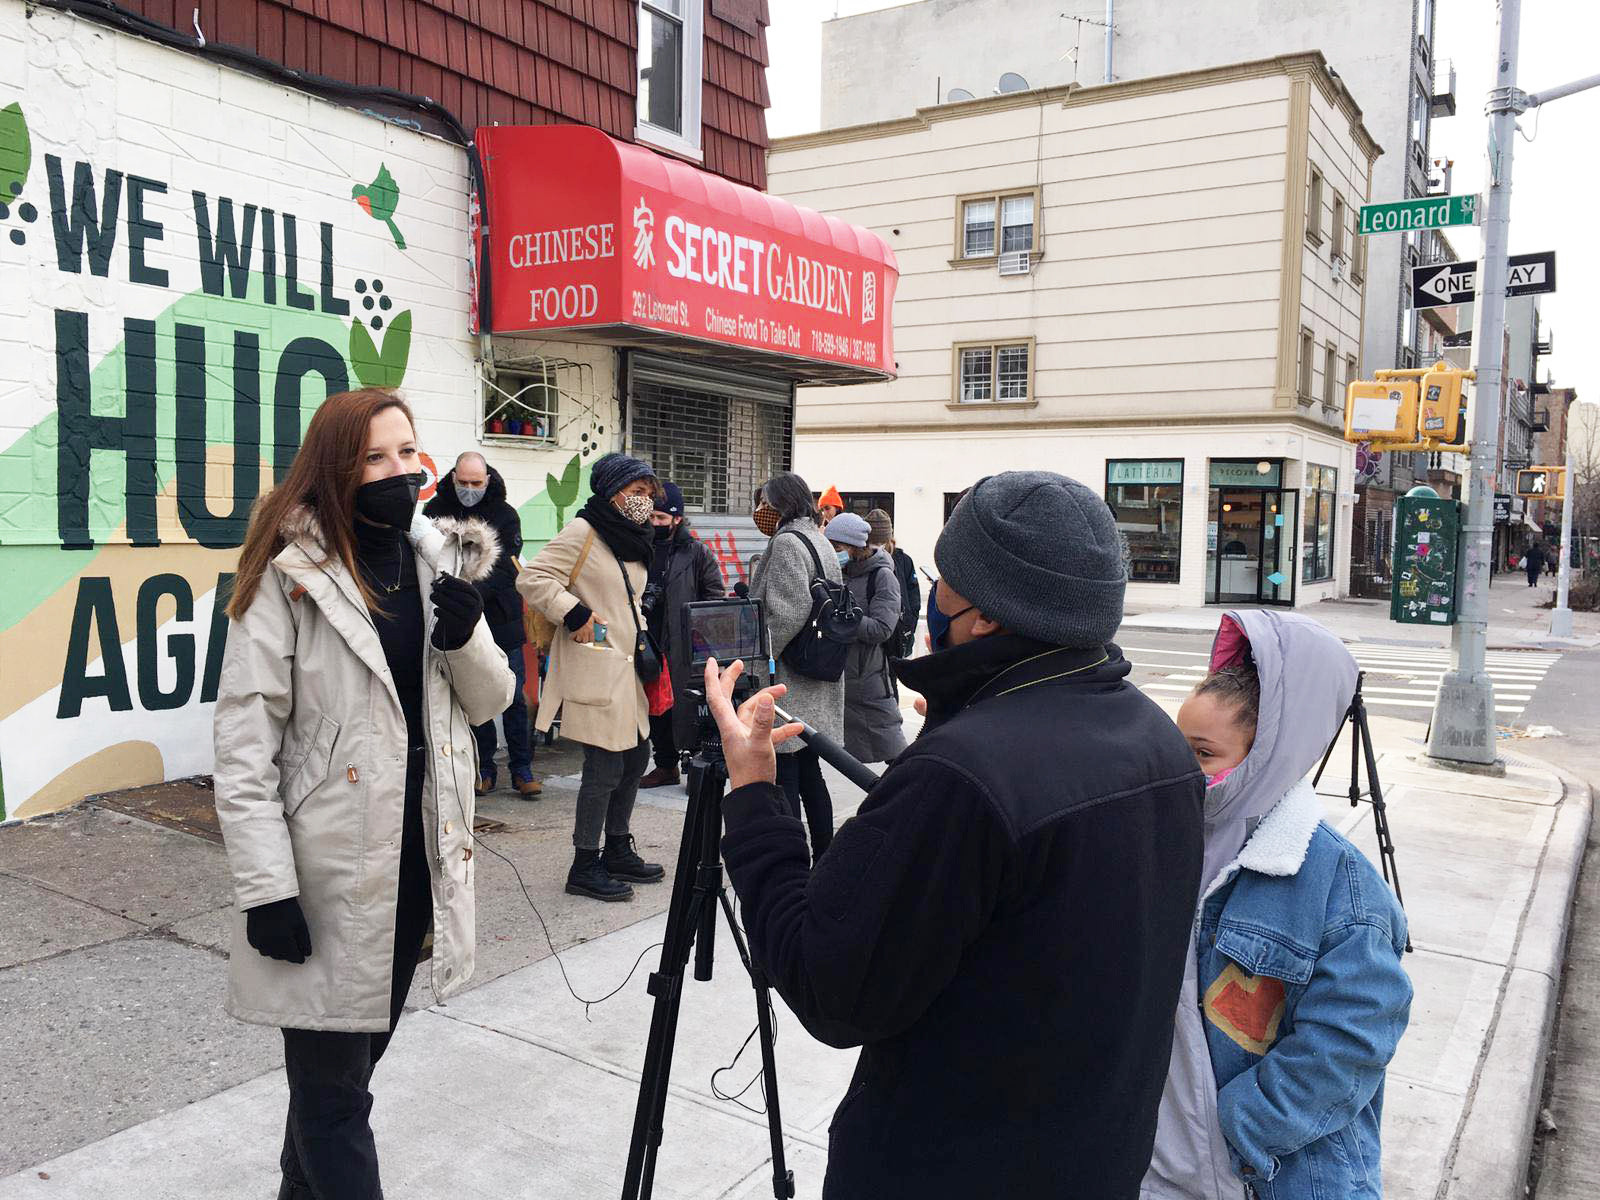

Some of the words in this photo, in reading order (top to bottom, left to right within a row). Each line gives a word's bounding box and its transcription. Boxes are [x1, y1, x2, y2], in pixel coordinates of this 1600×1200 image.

[45, 153, 169, 288] WE
[191, 189, 351, 317] WILL
[1361, 199, 1451, 233] Leonard
[508, 223, 615, 269] CHINESE
[632, 195, 656, 271] 家
[664, 215, 765, 297] SECRET
[766, 241, 853, 319] GARDEN
[528, 284, 599, 322] FOOD
[1434, 273, 1473, 294] ONE
[1508, 266, 1536, 285] AY
[632, 290, 647, 319] 292
[647, 293, 679, 326] Leonard
[679, 300, 691, 328] St.
[704, 306, 737, 337] Chinese
[737, 313, 758, 340] Food
[758, 318, 769, 343] To
[769, 320, 787, 346] Take
[787, 324, 801, 349] Out
[1117, 467, 1173, 479] LATTERIA
[56, 572, 236, 719] AG
